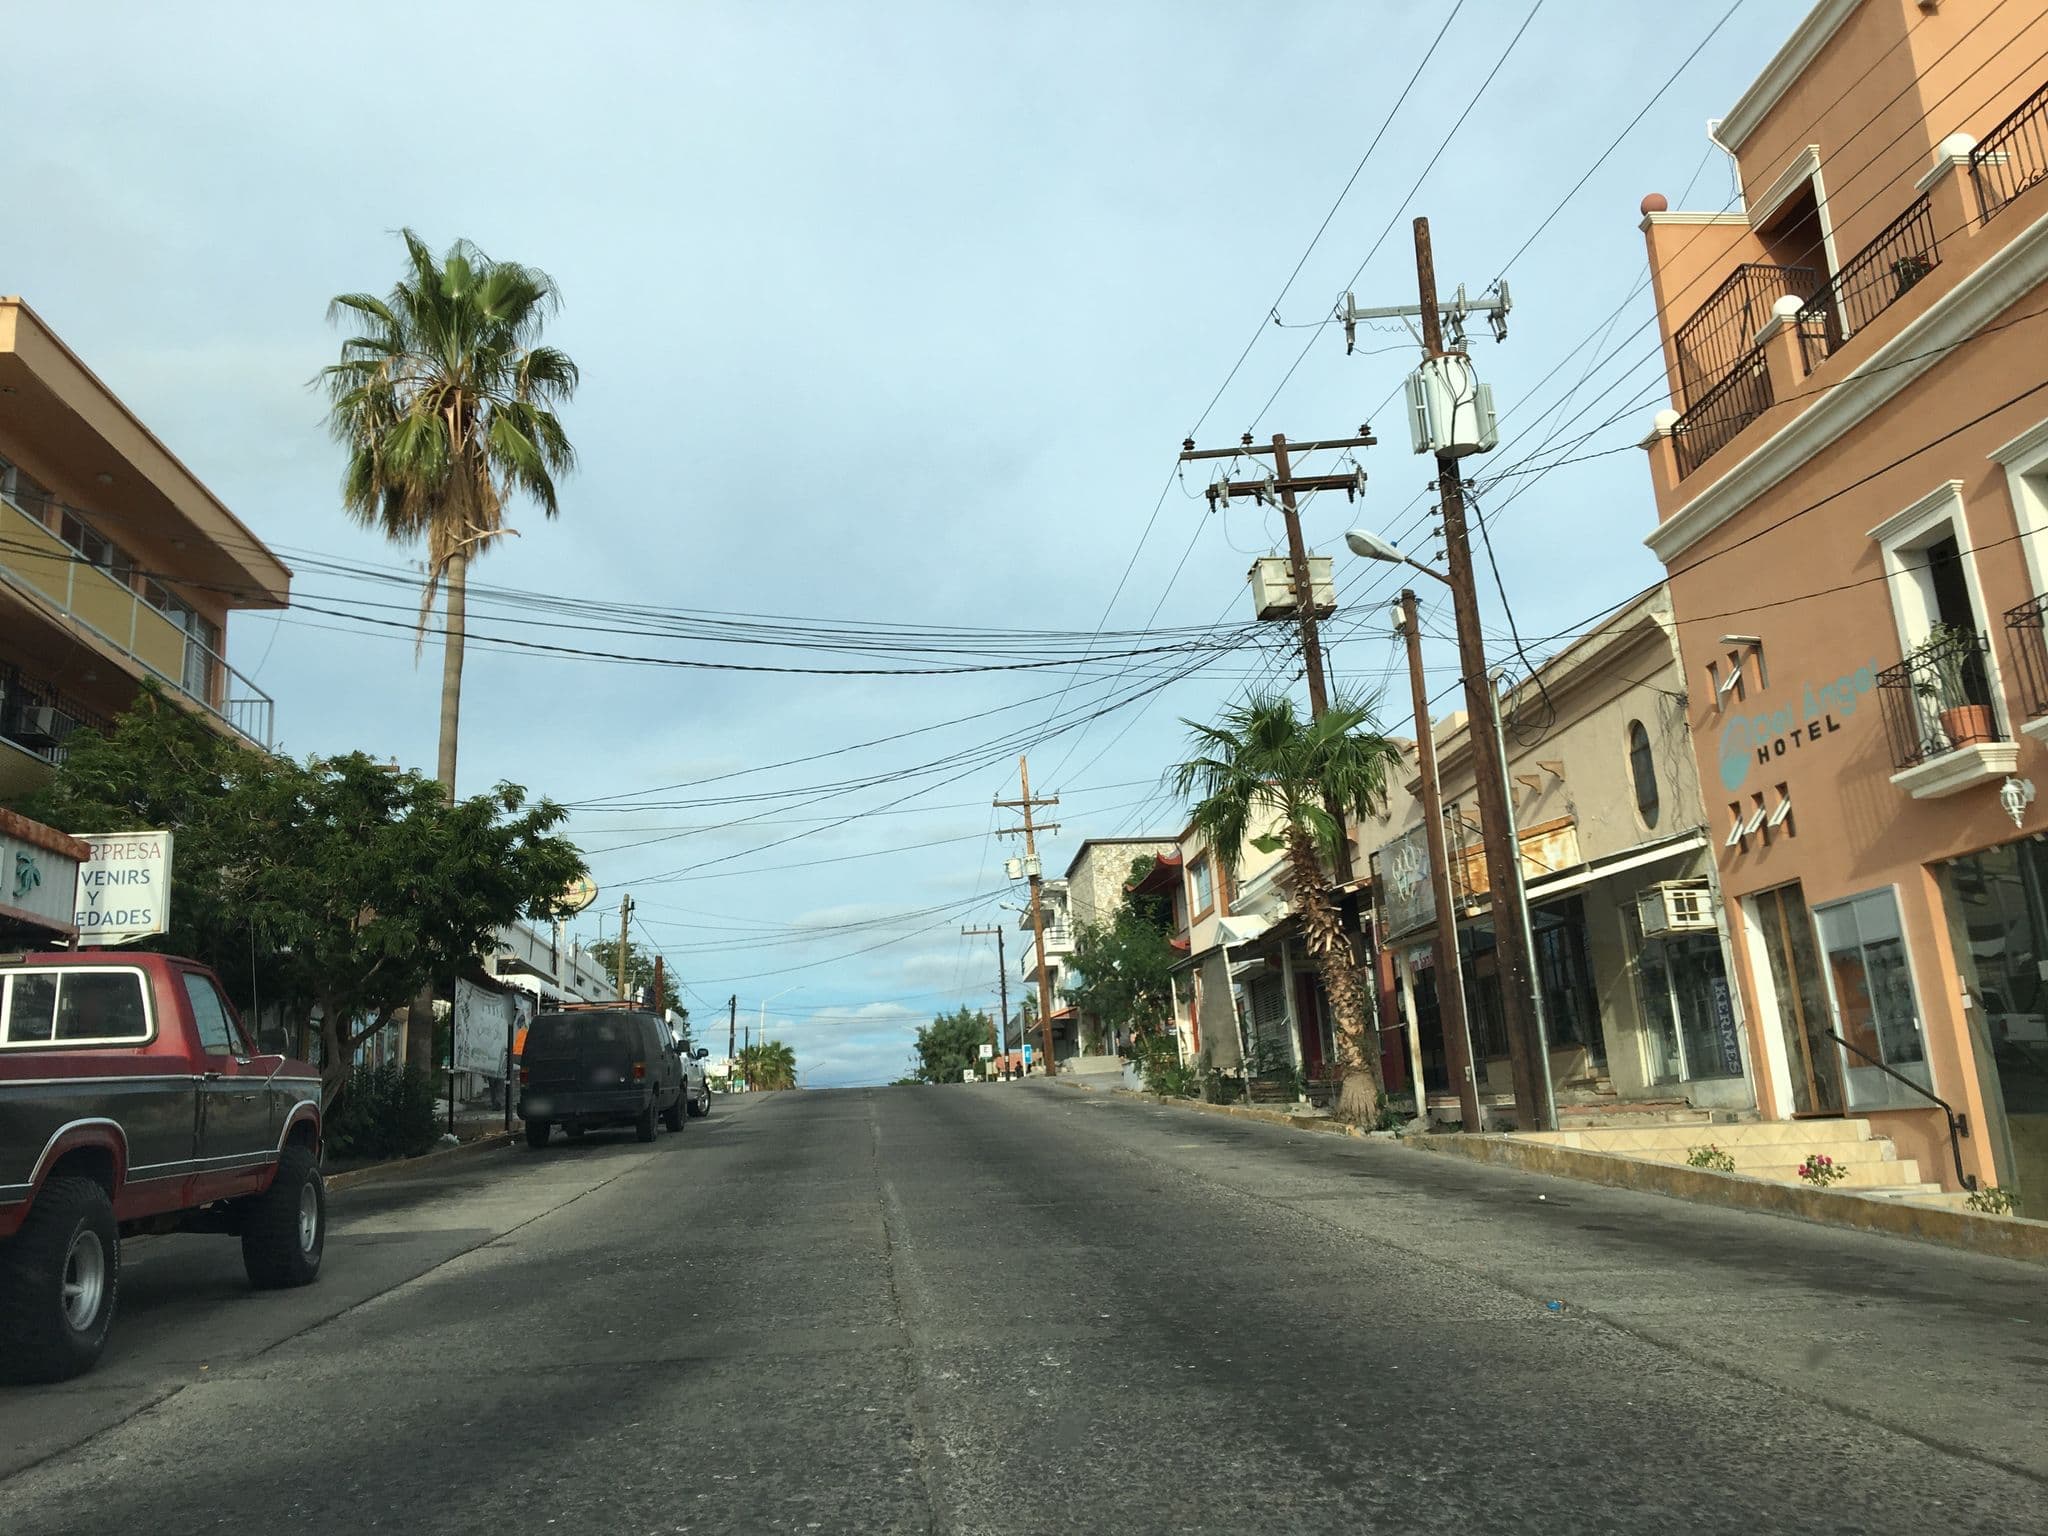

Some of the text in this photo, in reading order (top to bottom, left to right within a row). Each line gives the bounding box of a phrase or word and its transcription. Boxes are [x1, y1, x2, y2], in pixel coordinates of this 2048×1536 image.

[1758, 715, 1840, 765] HOTEL
[81, 869, 150, 886] VENIRS
[87, 891, 99, 906] Y
[76, 909, 151, 927] EDADES
